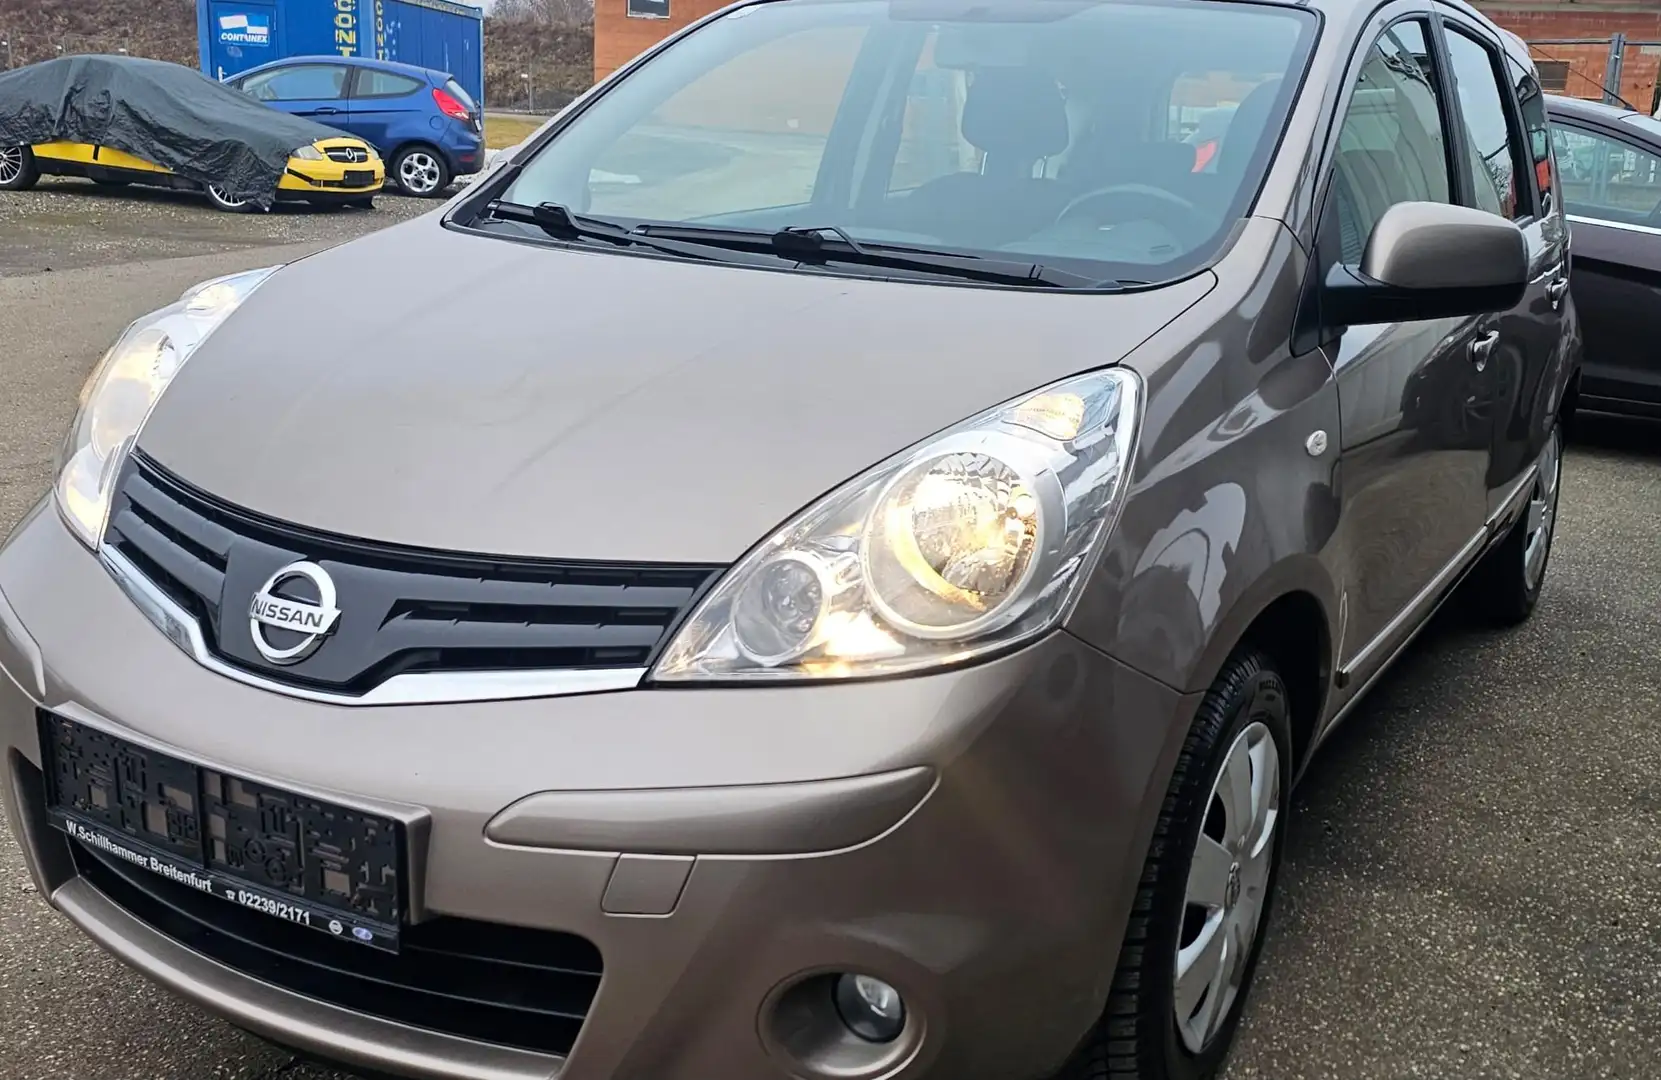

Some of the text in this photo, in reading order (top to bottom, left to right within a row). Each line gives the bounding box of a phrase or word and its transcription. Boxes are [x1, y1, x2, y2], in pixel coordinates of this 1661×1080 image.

[221, 32, 267, 43] CONTAINEX
[251, 598, 324, 628] NISSAN
[150, 857, 212, 892] Breitenfurt
[238, 890, 310, 925] 02239/2171
